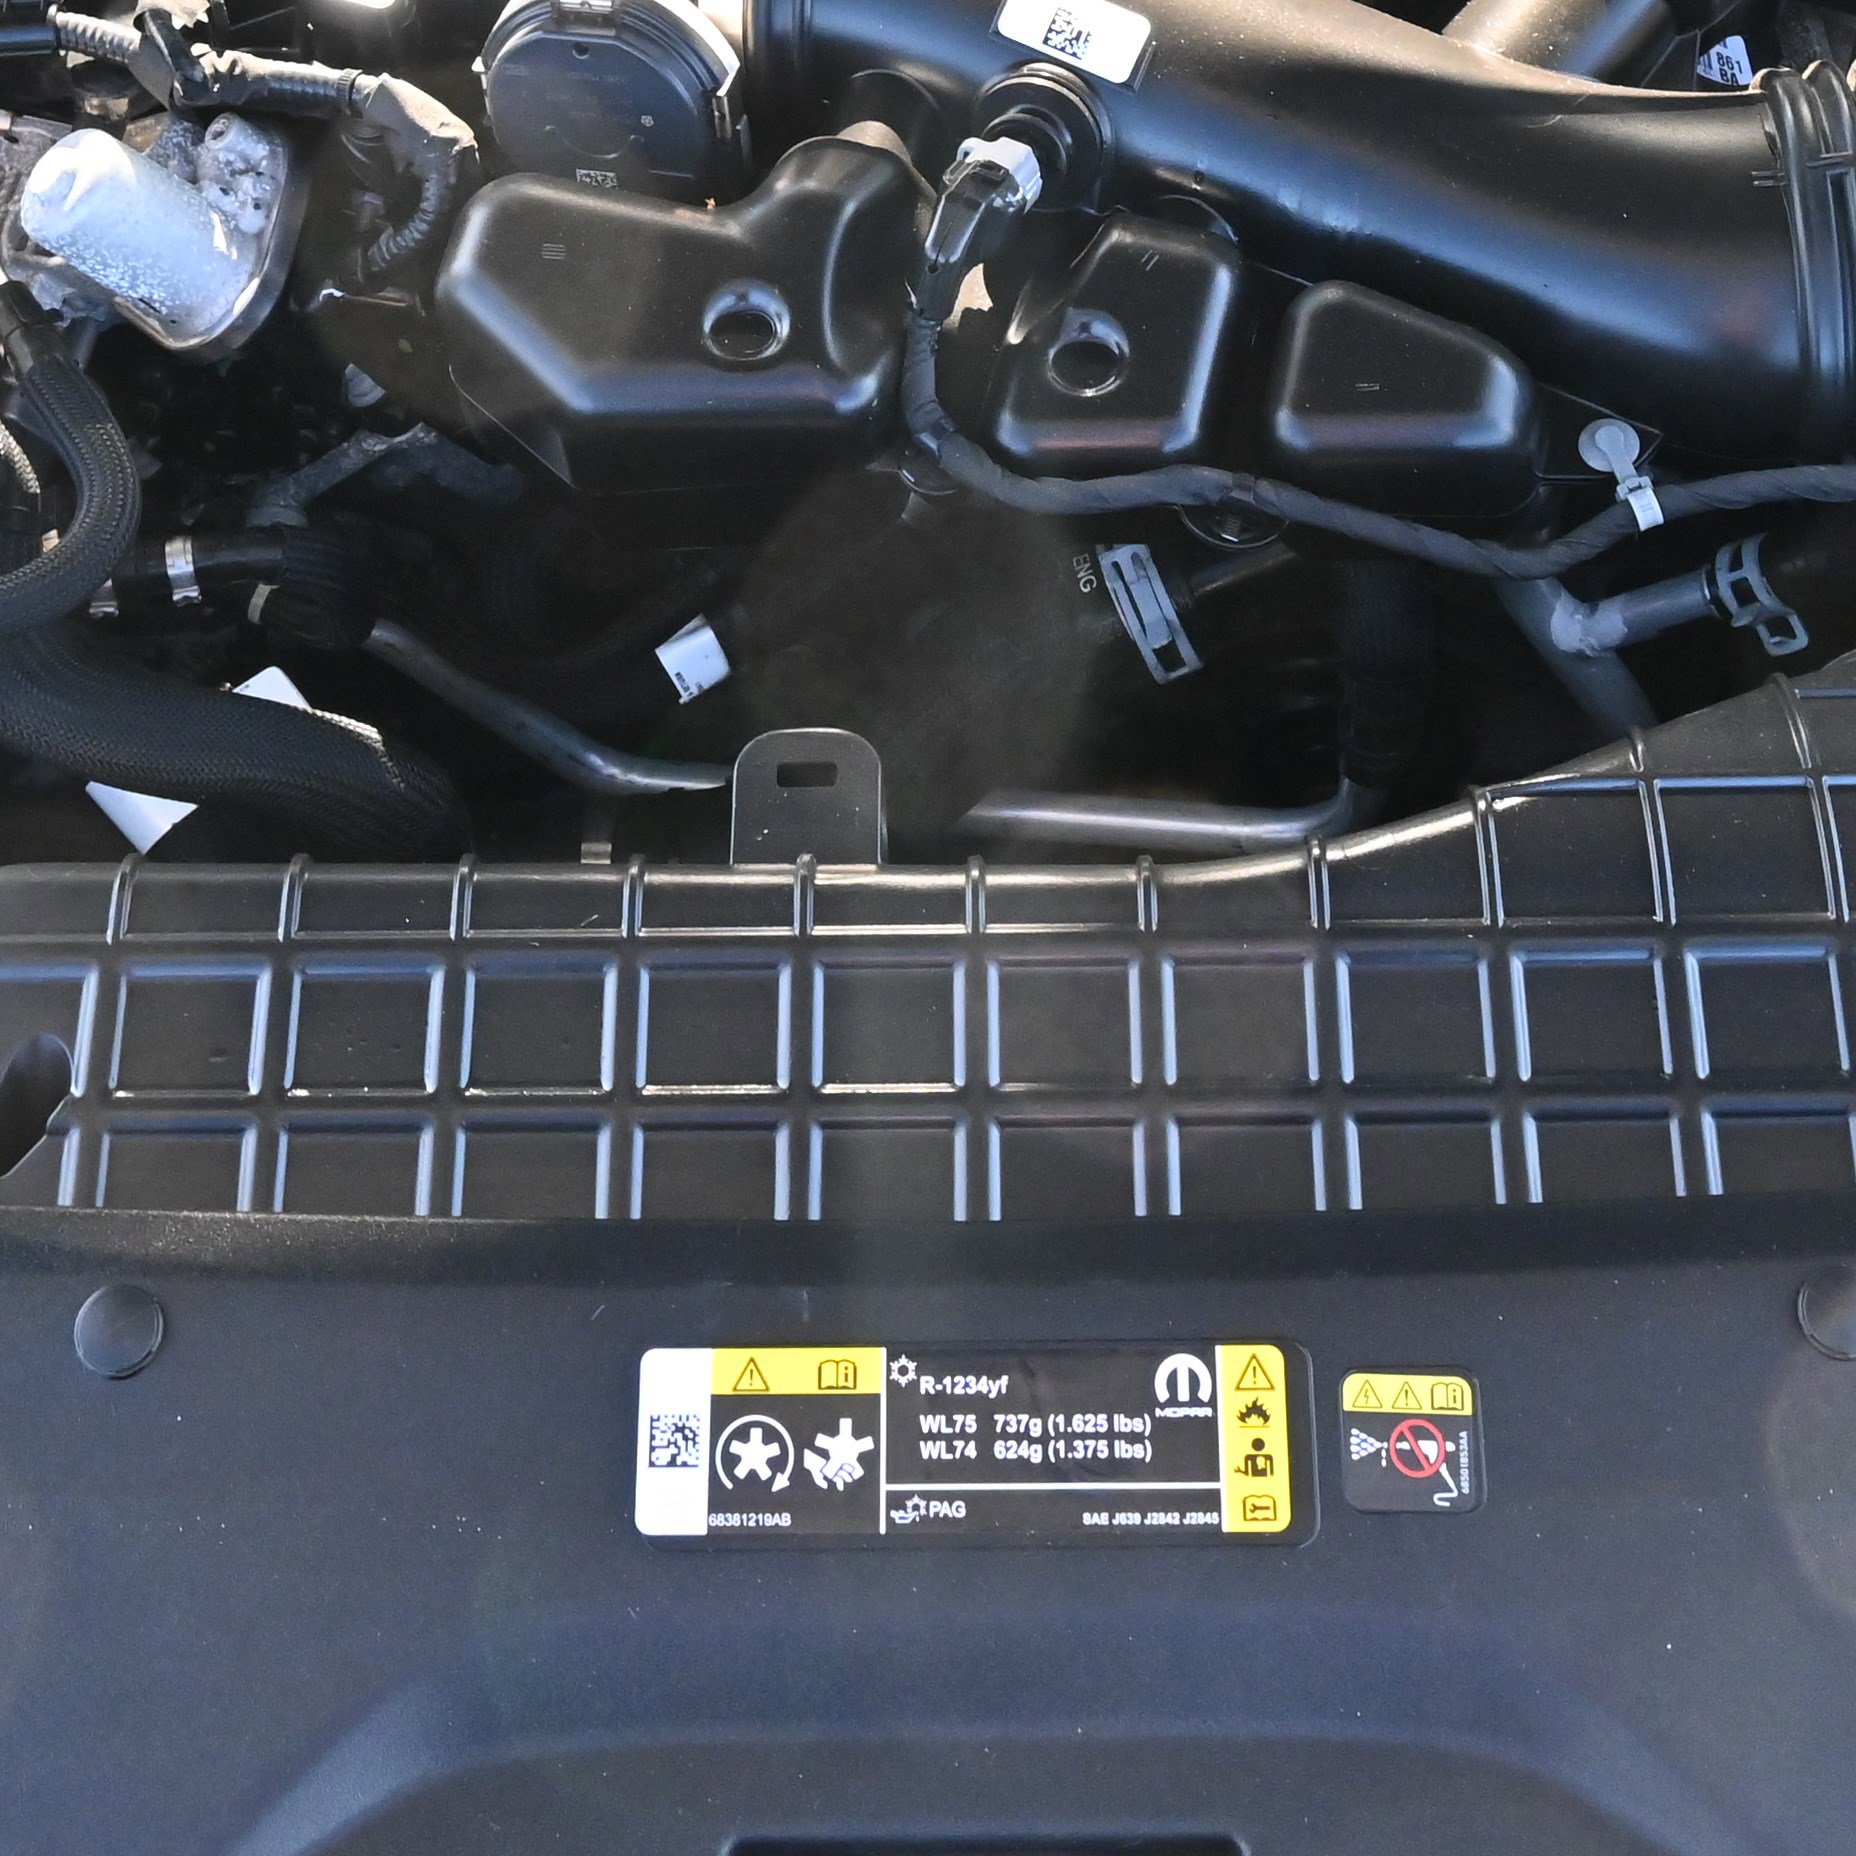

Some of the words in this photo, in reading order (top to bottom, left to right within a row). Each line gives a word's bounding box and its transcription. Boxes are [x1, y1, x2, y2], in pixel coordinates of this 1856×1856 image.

[1716, 51, 1743, 74] 861
[1073, 553, 1097, 593] ENG
[919, 1375, 1009, 1399] R-1234yf
[919, 1414, 977, 1433] WL75
[993, 1414, 1042, 1437] 737g
[1047, 1413, 1108, 1437] (1.625
[1113, 1413, 1151, 1437] lbs)
[919, 1440, 977, 1459] WL74
[993, 1440, 1042, 1464] 624g
[1047, 1440, 1108, 1463] (1.375
[1113, 1440, 1152, 1463] lbs)
[709, 1512, 792, 1527] 68381219AB
[929, 1500, 966, 1518] PAG
[1082, 1512, 1109, 1525] SAE
